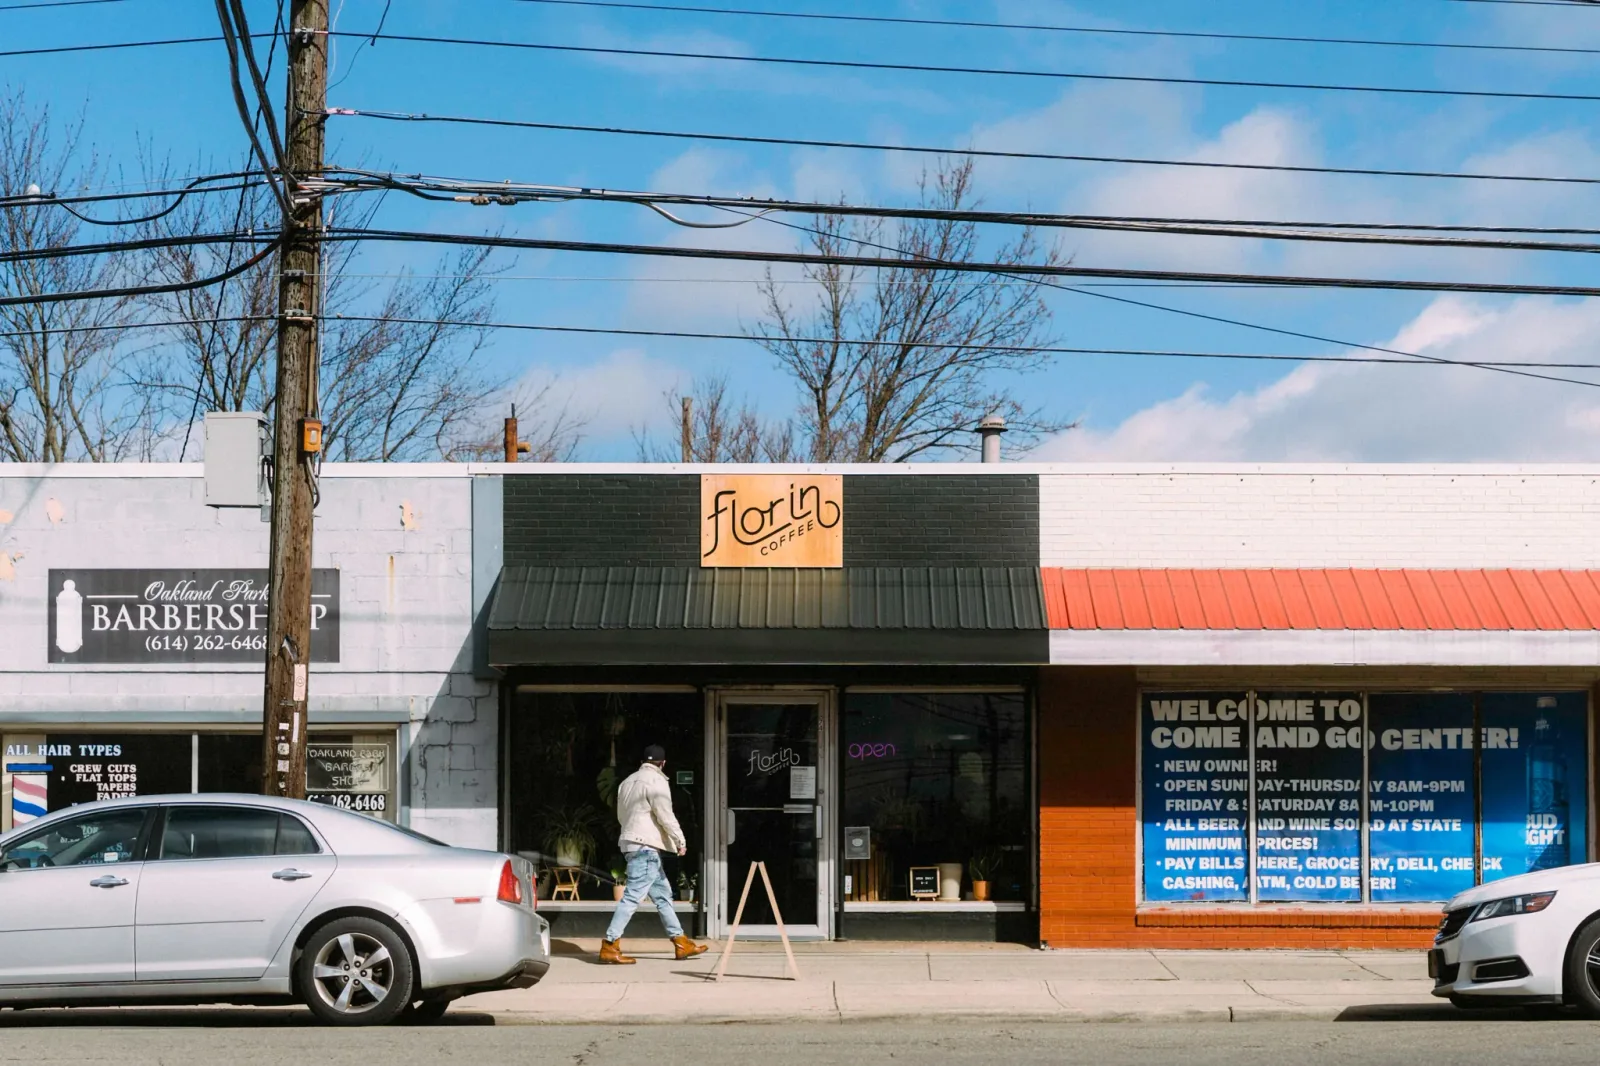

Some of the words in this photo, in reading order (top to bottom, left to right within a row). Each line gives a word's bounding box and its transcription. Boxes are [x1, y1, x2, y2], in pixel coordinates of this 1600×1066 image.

[760, 520, 814, 556] COFFEE
[144, 579, 224, 601] Oakland
[221, 579, 270, 601] Park
[90, 603, 327, 631] BARBERSHP
[145, 635, 188, 652] (614)
[1150, 699, 1314, 721] WELCOME
[1320, 699, 1361, 721] TO
[1151, 727, 1240, 749] COME
[1256, 727, 1320, 748] AND
[1325, 726, 1376, 750] GO
[1381, 728, 1519, 750] CENTER!
[6, 744, 31, 756] ALL
[38, 744, 72, 756] HAIR
[79, 744, 122, 756] TYPES
[309, 749, 357, 758] OAKLAND
[848, 743, 896, 761] open
[69, 764, 102, 773] CREW
[107, 764, 137, 773] CUTS
[1163, 760, 1200, 772] NEW
[1204, 760, 1278, 772] OWNER!
[76, 773, 102, 782] FLAT
[108, 773, 137, 782] TOPS
[96, 782, 137, 791] TAPERS
[1164, 779, 1207, 791] OPEN
[1211, 779, 1383, 792] SUNDAY-THURSDAY
[1387, 780, 1465, 793] 8AM-9PM
[1165, 799, 1223, 811] FRIDAY
[1226, 799, 1239, 811] &
[1242, 799, 1335, 811] SATURDAY
[1338, 799, 1434, 812] 8AM-10PM
[1164, 818, 1195, 831] ALL
[1198, 818, 1239, 831] BEER
[1242, 818, 1286, 830] AND
[1288, 818, 1331, 830] WINE
[1333, 818, 1385, 831] SOLD
[1387, 819, 1409, 831] AT
[1412, 819, 1461, 831] STATE
[1165, 837, 1241, 850] MINIMUM
[1256, 837, 1318, 850] PRICES!
[1164, 857, 1196, 870] PAY
[1199, 857, 1245, 870] BILLS
[1256, 857, 1303, 872] HERE,
[1305, 857, 1395, 872] GROCERY,
[1397, 858, 1438, 872] DELI,
[1441, 857, 1503, 870] CHECK
[1162, 877, 1239, 891] CASHING,
[1242, 876, 1291, 890] ATM,
[1294, 876, 1337, 889] COLD
[1340, 876, 1396, 889] BEER!
